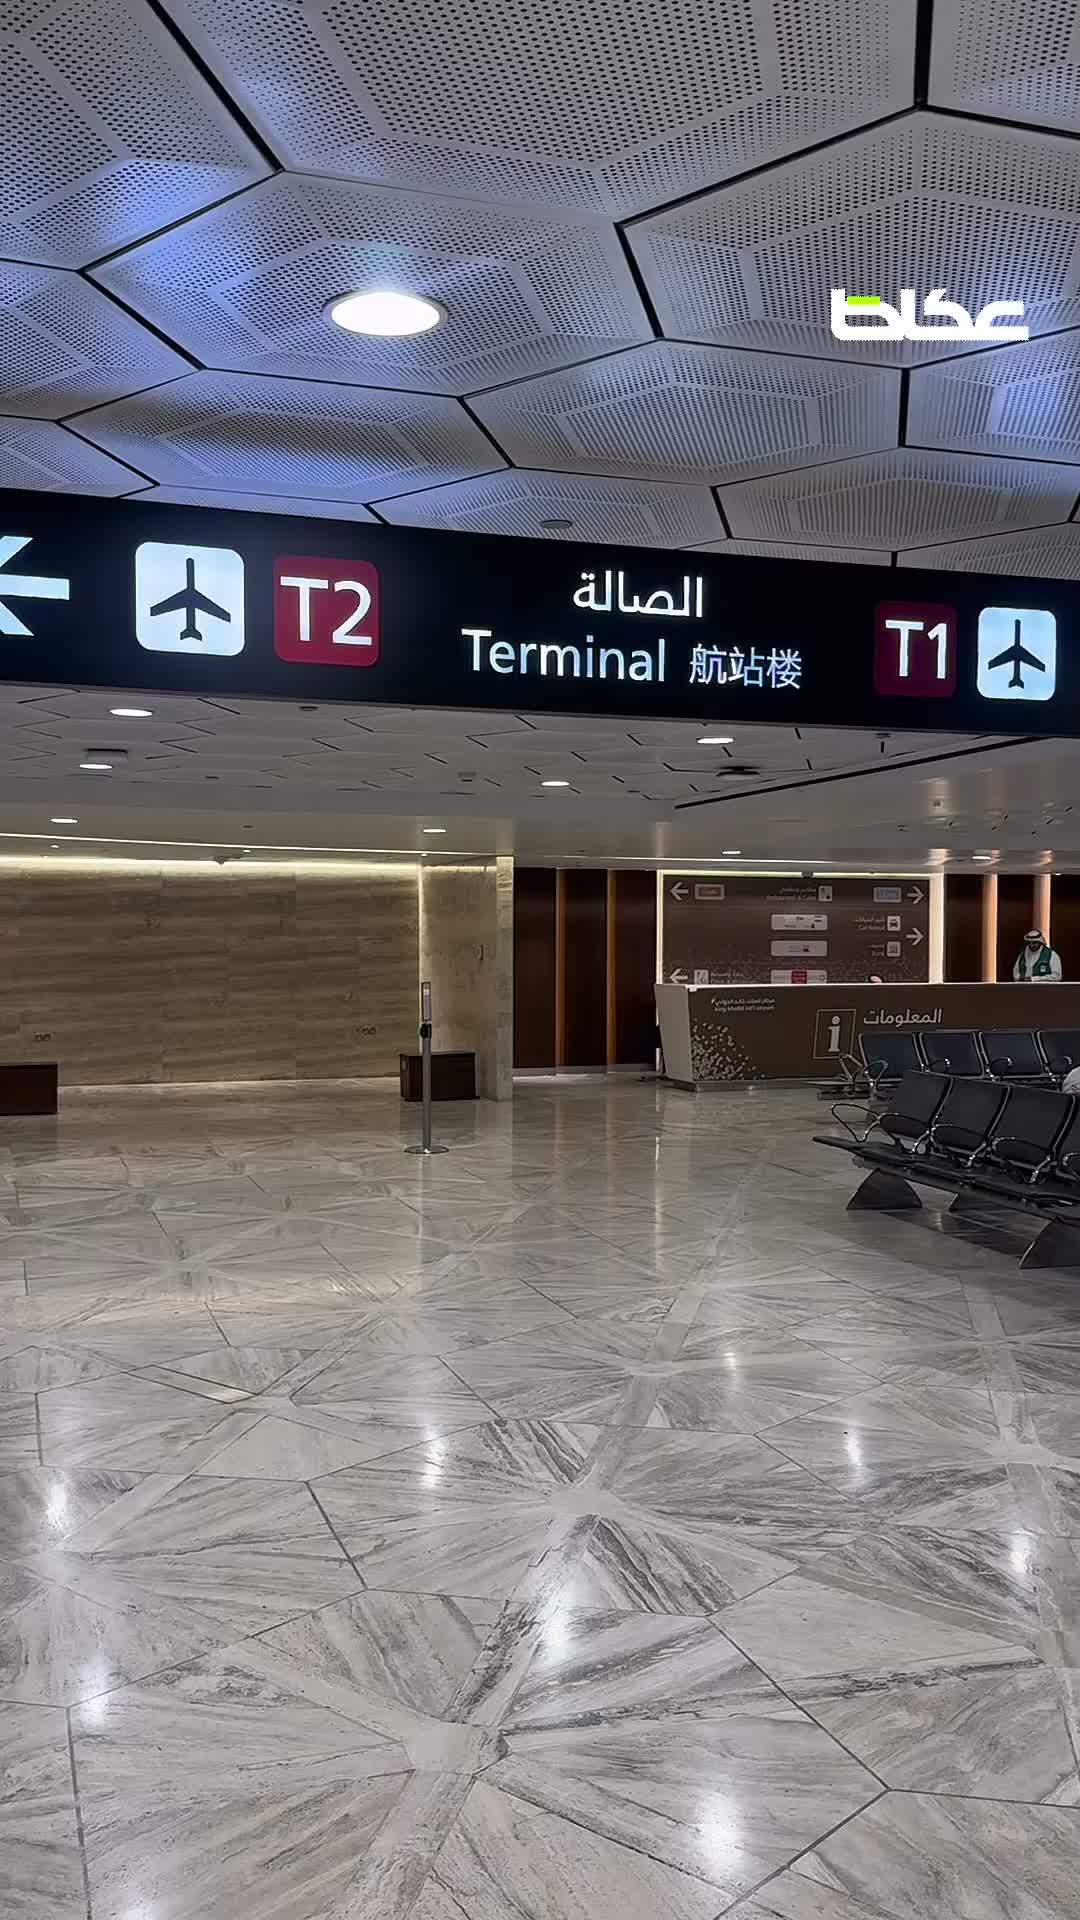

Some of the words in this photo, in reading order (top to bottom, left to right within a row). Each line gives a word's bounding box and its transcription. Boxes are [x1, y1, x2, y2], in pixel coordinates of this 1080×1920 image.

[280, 575, 372, 646] T2
[572, 569, 704, 618] الصالة
[461, 628, 666, 682] Terminal
[688, 643, 803, 690] 航站楼
[885, 619, 947, 680] T1
[863, 1008, 943, 1028] المعلومات
